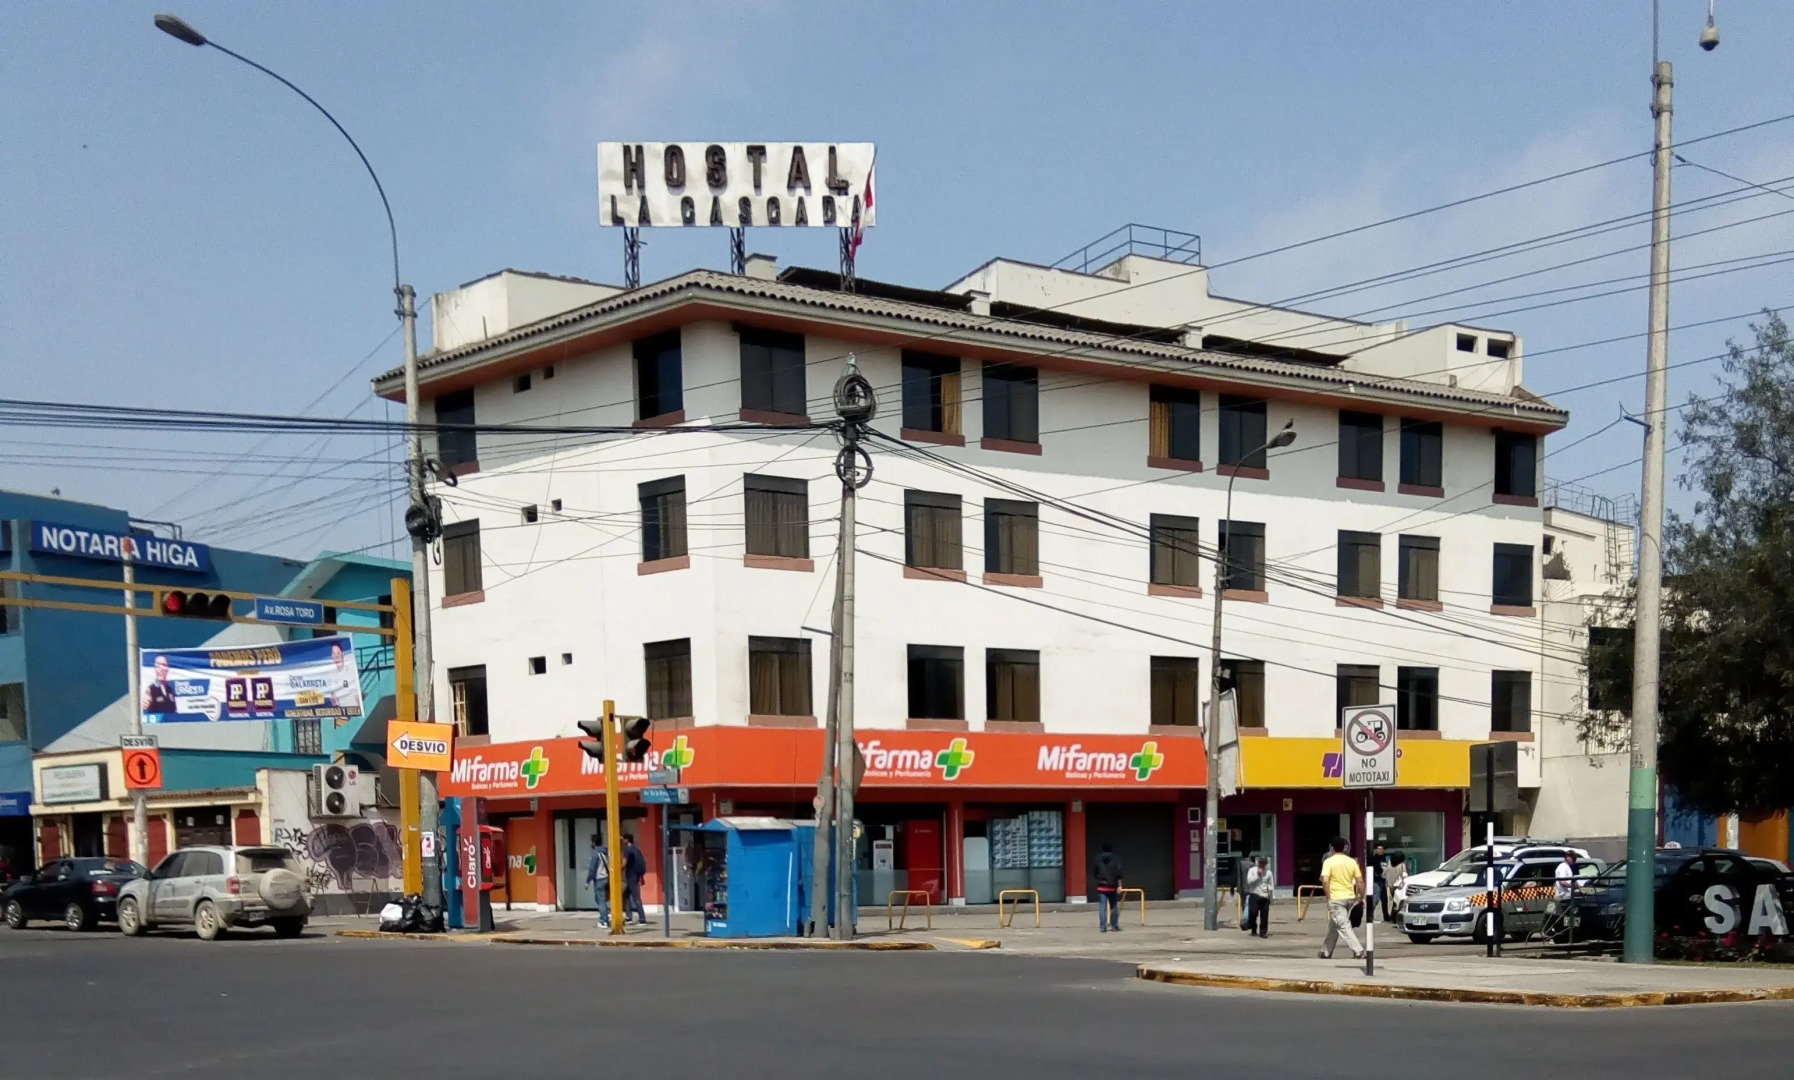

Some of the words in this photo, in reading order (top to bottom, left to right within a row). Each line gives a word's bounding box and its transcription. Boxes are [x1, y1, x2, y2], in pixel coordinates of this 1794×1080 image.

[622, 144, 850, 192] HOSTAL
[611, 194, 652, 225] LA
[680, 194, 863, 226] CASCADA
[146, 540, 199, 568] HIGA
[295, 607, 315, 618] TORO
[123, 737, 155, 747] DESVIO
[400, 739, 446, 753] DESVIO
[836, 740, 933, 769] ifarma
[451, 755, 519, 783] Mifarma
[1037, 744, 1128, 772] Mifarma
[1361, 757, 1377, 768] NO
[1349, 771, 1390, 783] MOTOTAXI
[466, 842, 477, 889] Claro
